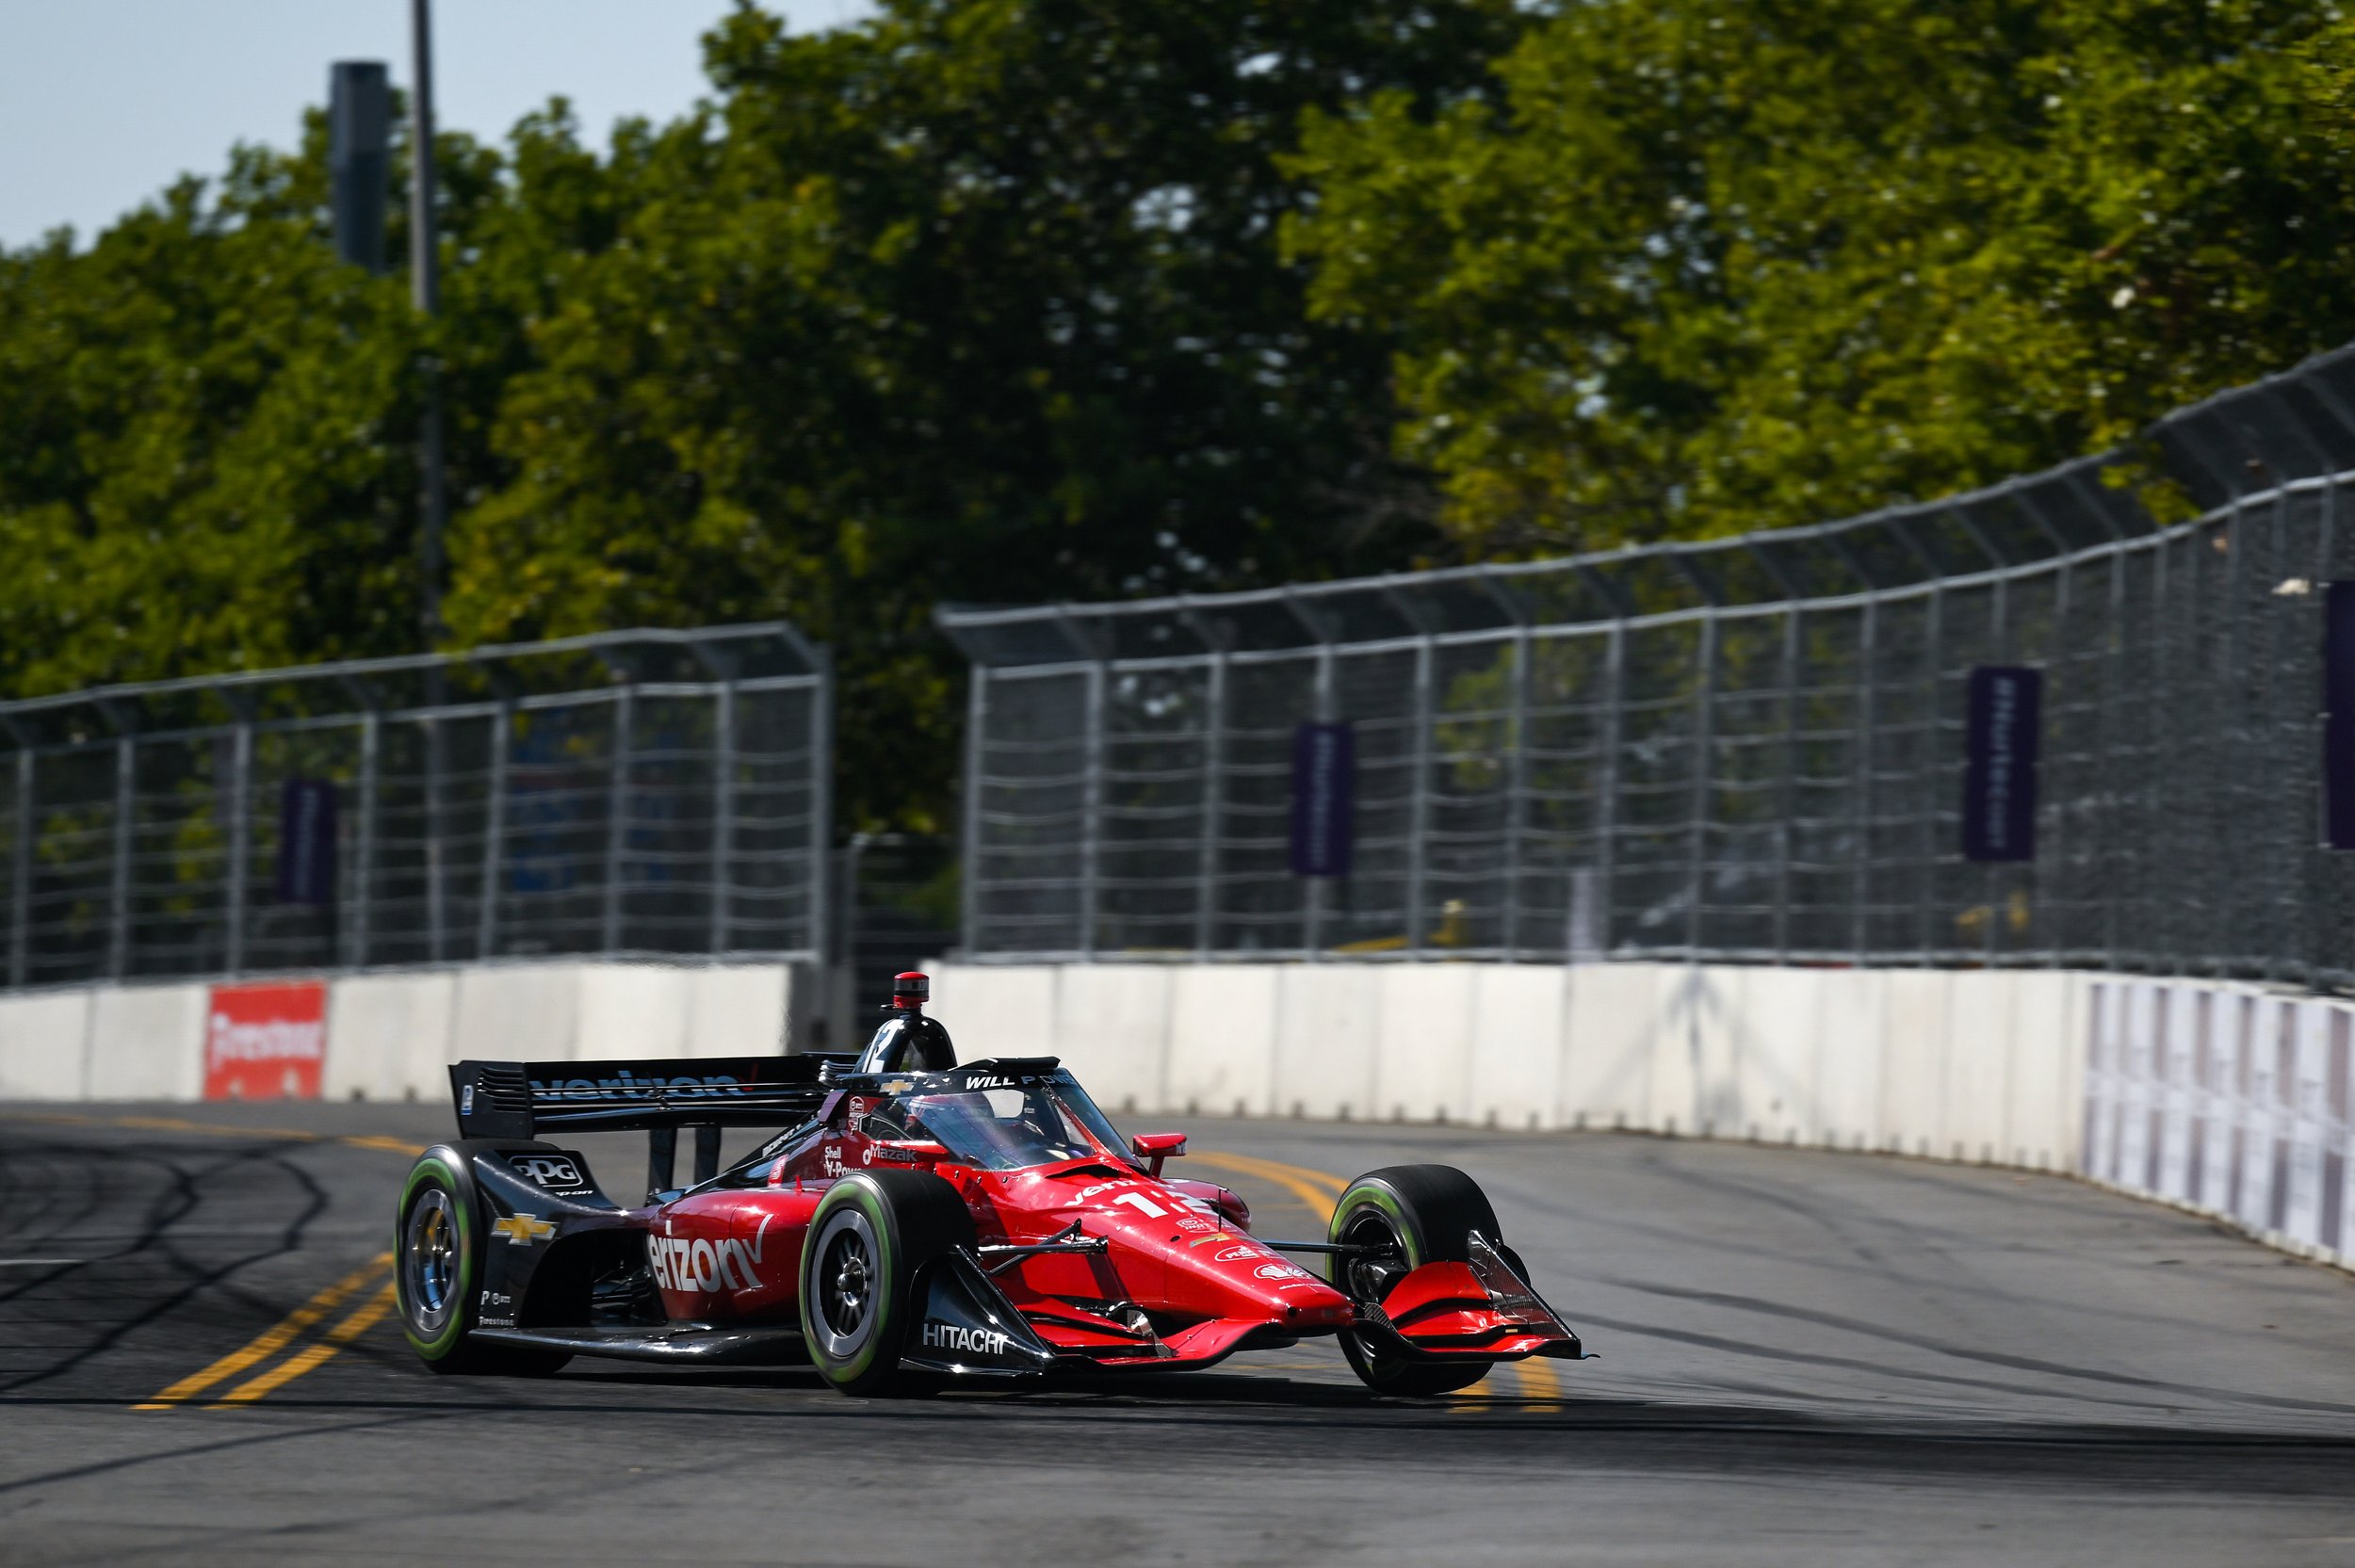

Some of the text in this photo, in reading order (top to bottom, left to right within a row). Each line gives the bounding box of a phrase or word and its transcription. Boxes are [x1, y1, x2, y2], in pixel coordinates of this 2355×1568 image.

[530, 1070, 746, 1100] verizon
[966, 1076, 1015, 1090] WILL
[825, 1146, 842, 1159] Shell
[870, 1144, 918, 1162] Mazak
[514, 1160, 577, 1185] PPG
[647, 1220, 763, 1293] erizon
[923, 1323, 1006, 1355] HITACHI
